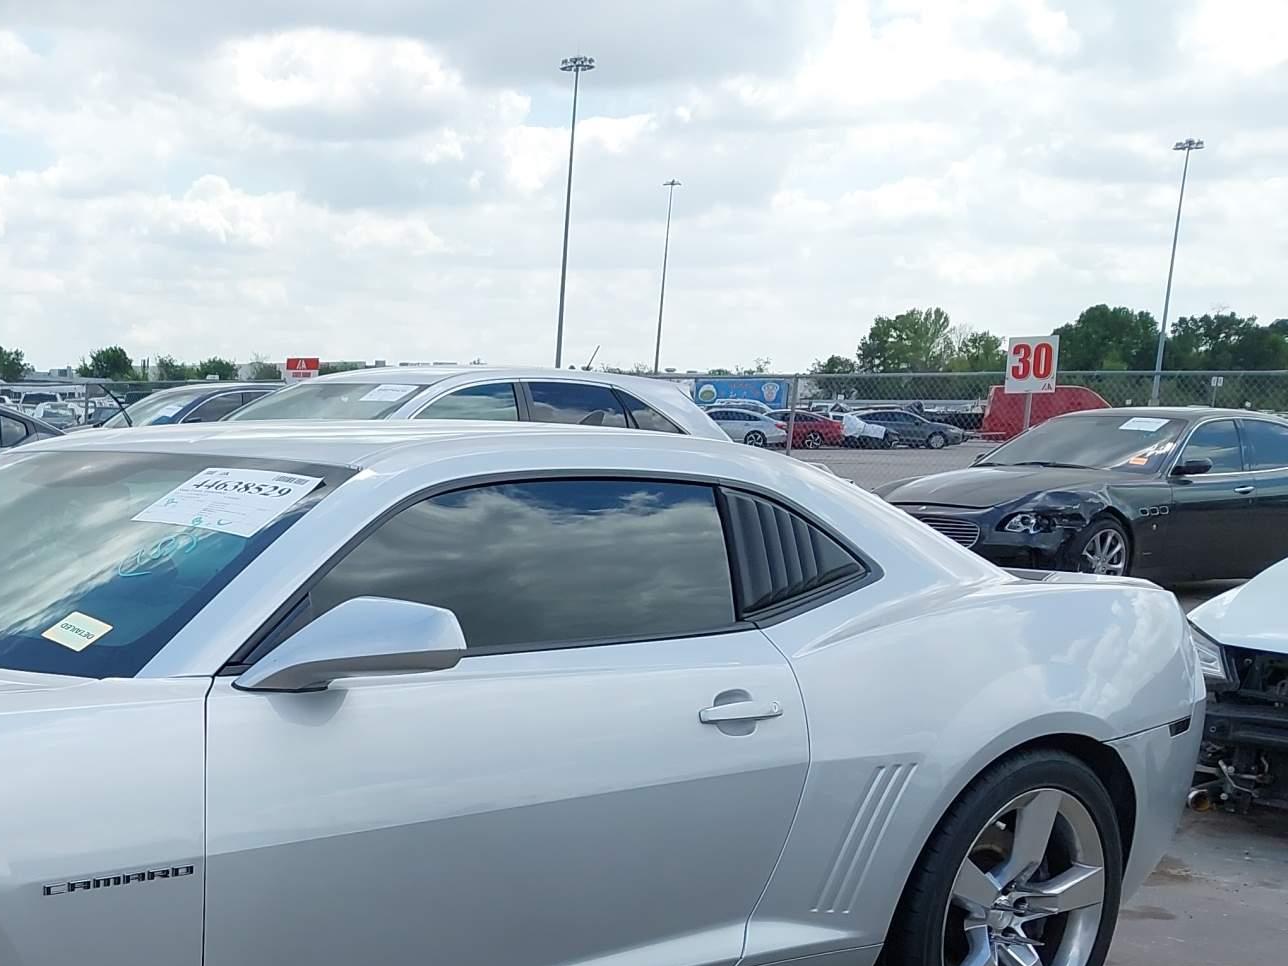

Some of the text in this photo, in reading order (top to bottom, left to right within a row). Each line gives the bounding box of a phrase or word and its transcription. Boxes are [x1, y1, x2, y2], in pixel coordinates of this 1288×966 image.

[1011, 343, 1053, 379] 30
[193, 478, 292, 498] 44638529
[60, 622, 95, 640] DETAILED
[43, 865, 194, 896] CAMARO
